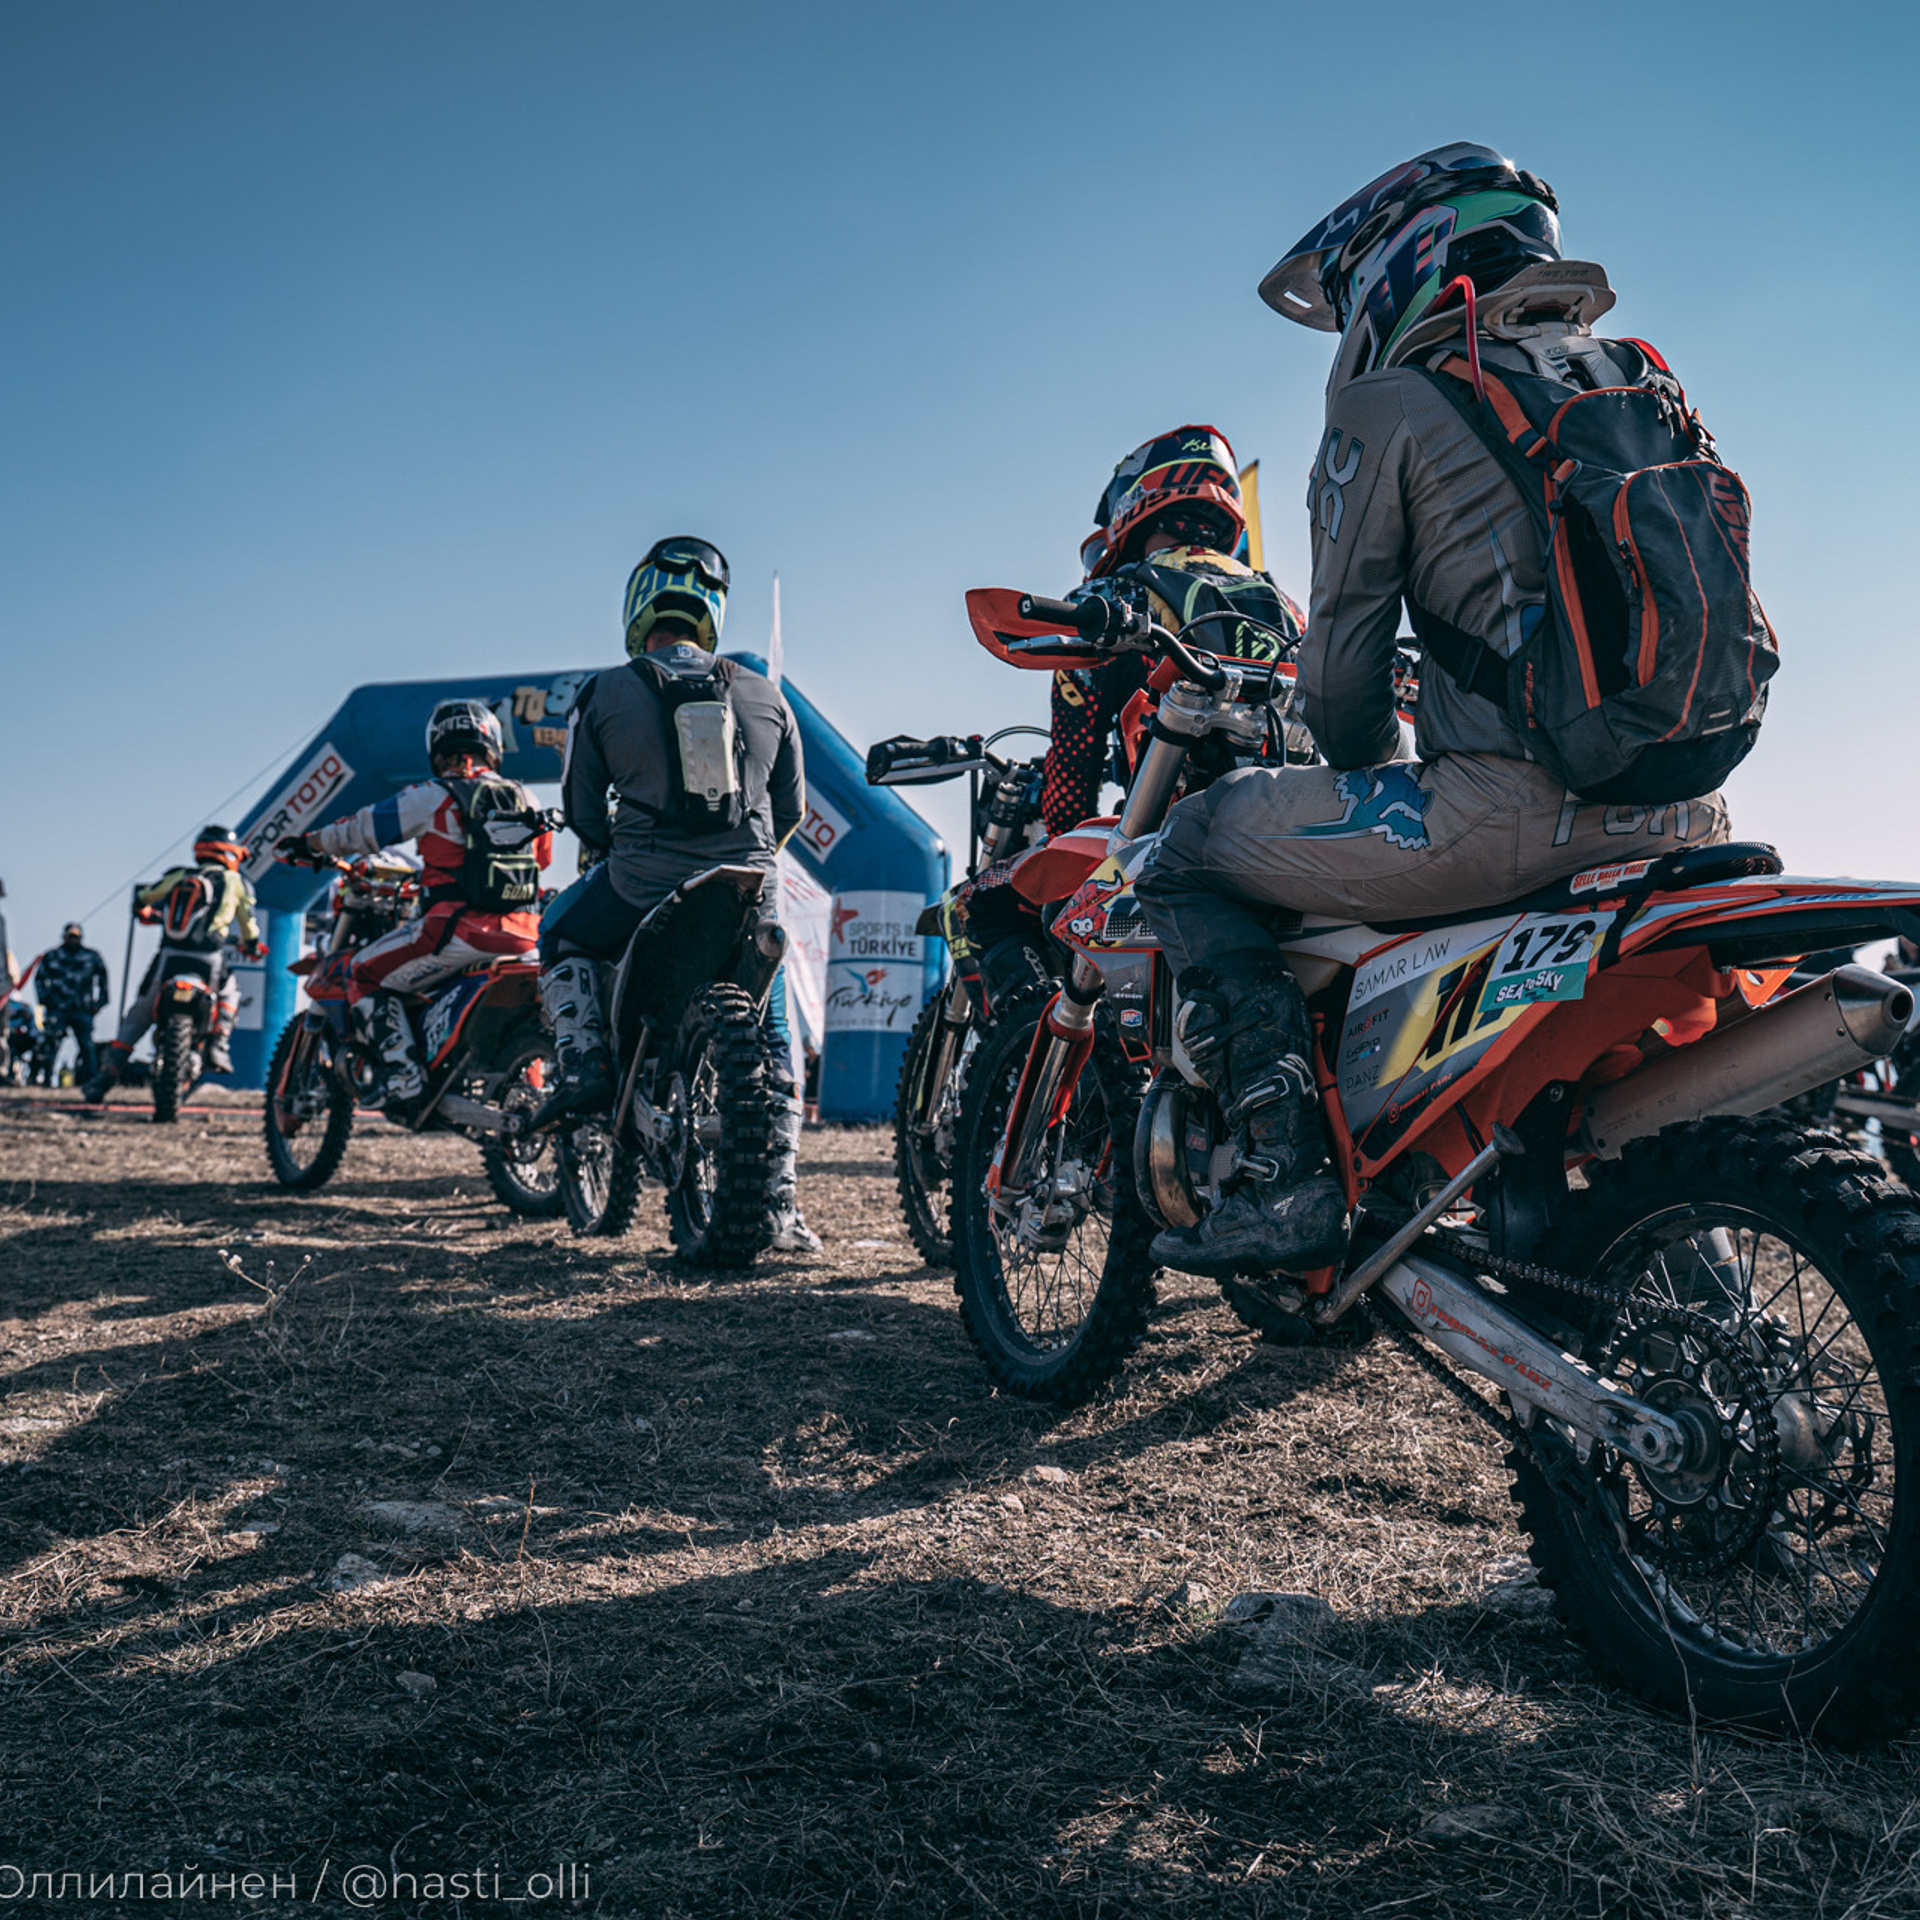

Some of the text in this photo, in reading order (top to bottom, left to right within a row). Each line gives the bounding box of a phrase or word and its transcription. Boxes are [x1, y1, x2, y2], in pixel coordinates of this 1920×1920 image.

[848, 936, 917, 957] TÜRKİYE
[1502, 920, 1597, 974] 179
[1354, 937, 1451, 1000] SAMAR LAW
[1495, 983, 1525, 1003] SEA
[1534, 970, 1565, 992] SKY
